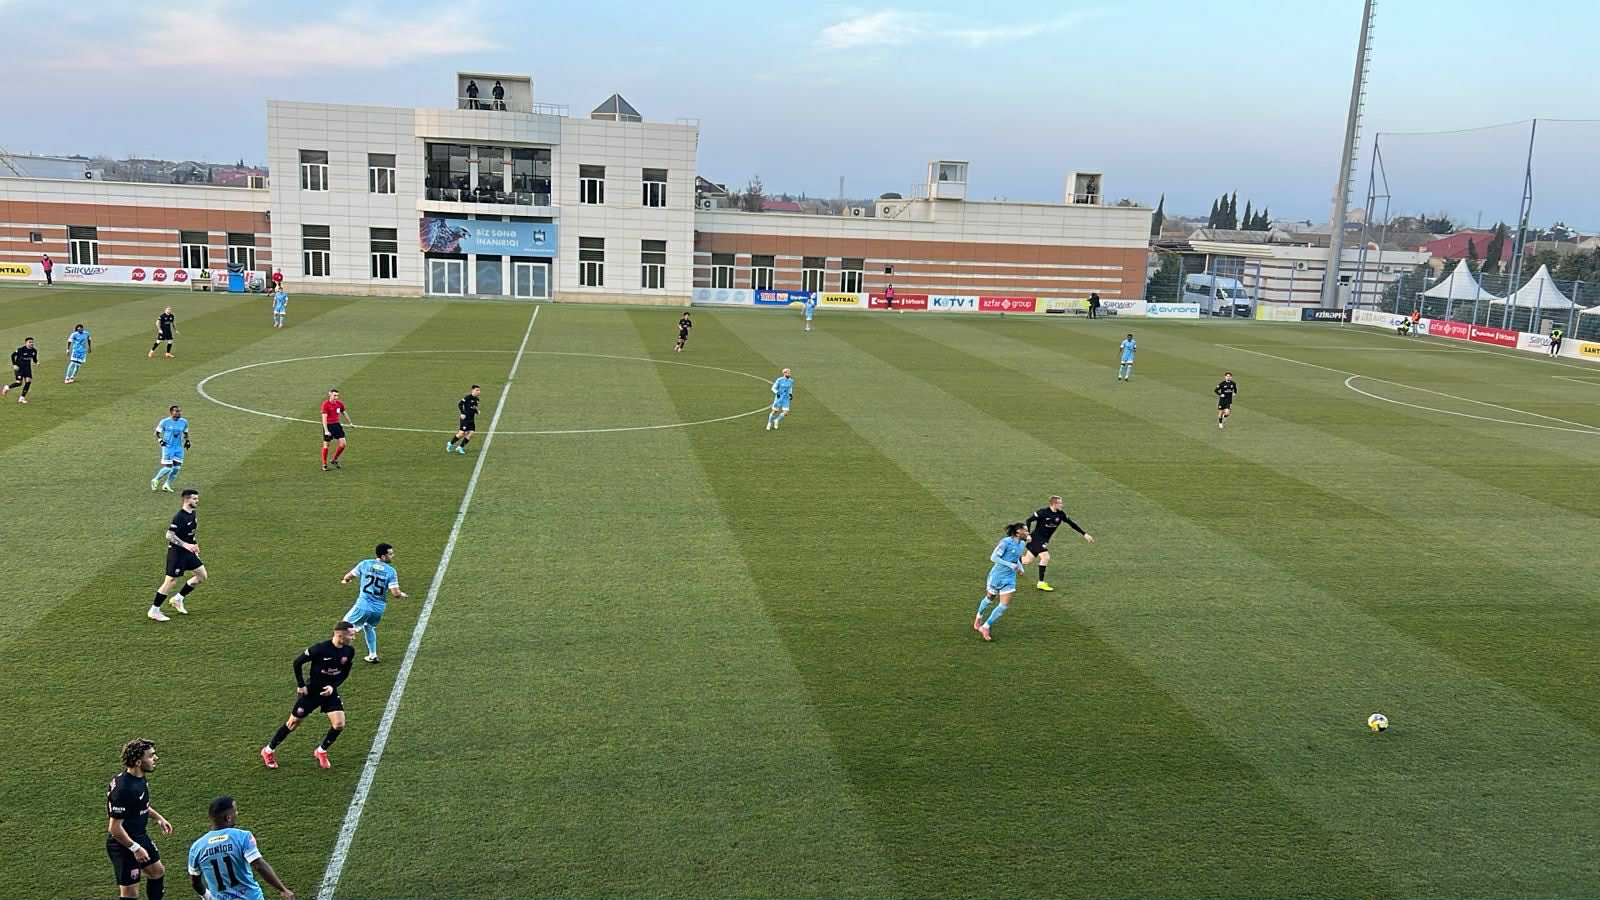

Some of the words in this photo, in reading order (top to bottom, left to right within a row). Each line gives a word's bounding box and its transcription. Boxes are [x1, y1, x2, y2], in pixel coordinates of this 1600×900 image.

[1012, 300, 1032, 309] group
[362, 574, 386, 597] 25
[210, 855, 241, 892] 11
